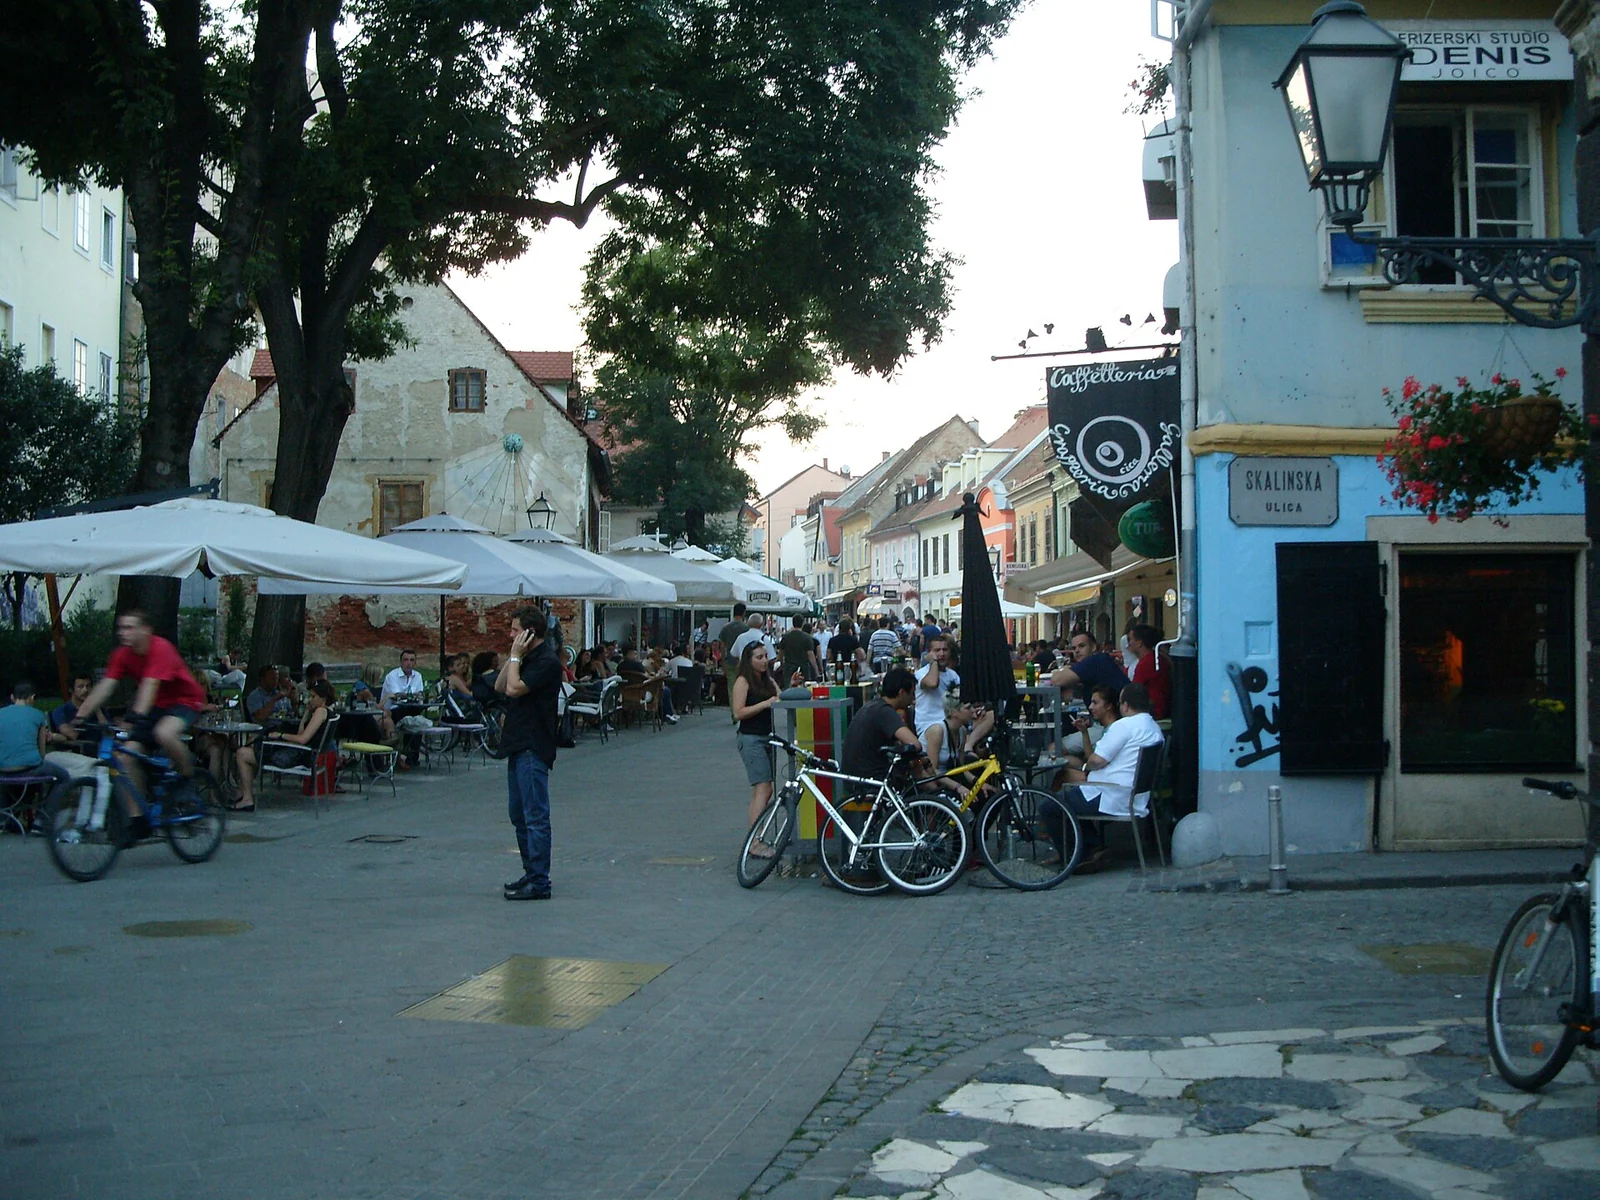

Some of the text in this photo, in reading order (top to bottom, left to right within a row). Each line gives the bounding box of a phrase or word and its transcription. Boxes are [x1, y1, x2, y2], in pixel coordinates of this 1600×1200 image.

[1398, 32, 1550, 45] FRIZERSKI STUDIO
[1409, 47, 1552, 66] DENIS
[1432, 67, 1520, 79] JOICO
[1050, 362, 1165, 393] Caffetteria
[1119, 421, 1181, 498] Galleria
[1119, 458, 1141, 474] cica
[1245, 470, 1322, 492] SKALINSKA
[1265, 502, 1303, 514] ULICA
